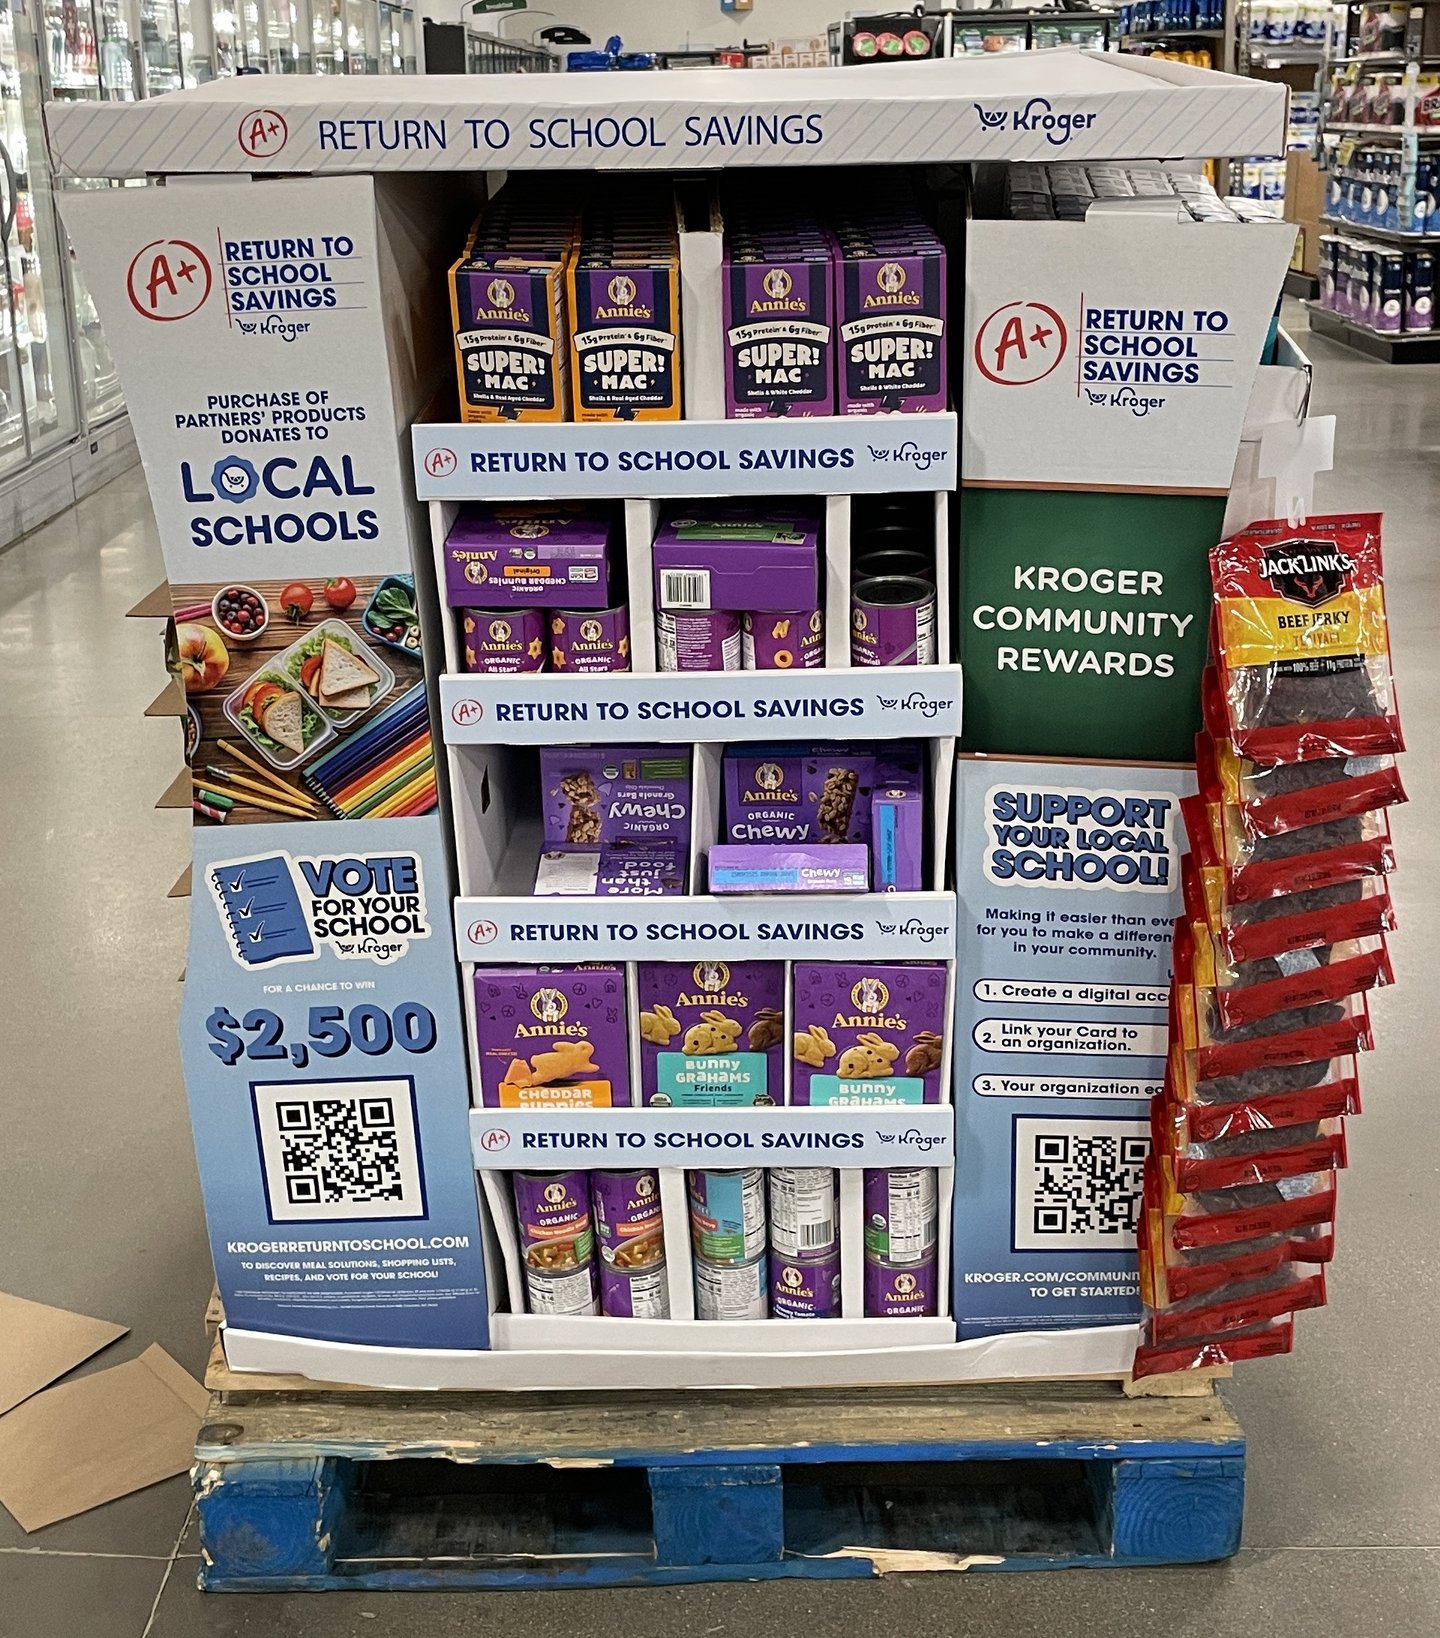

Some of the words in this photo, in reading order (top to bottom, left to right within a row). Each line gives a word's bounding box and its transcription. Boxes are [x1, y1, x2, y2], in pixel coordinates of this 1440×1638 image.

[1013, 98, 1097, 145] Kroger
[319, 119, 446, 149] RETURN
[464, 119, 510, 149] TO
[529, 117, 666, 148] SCHOOL
[685, 114, 823, 146] SAVINGS
[225, 238, 314, 262] RETURN
[321, 236, 354, 257] TO
[228, 263, 332, 287] SCHOOL
[231, 288, 337, 311] SAVINGS
[750, 298, 807, 314] Annie's
[863, 291, 920, 308] Annie's
[476, 307, 530, 323] Annie's
[595, 304, 652, 319] Annie's
[1086, 308, 1184, 331] RETURN
[1193, 311, 1228, 332] TO
[260, 314, 310, 342] Kroger
[738, 343, 820, 368] SUPER!
[850, 338, 934, 364] SUPER!
[1084, 335, 1198, 358] SCHOOL
[467, 351, 546, 376] SUPER!
[584, 350, 665, 374] SUPER!
[868, 363, 915, 380] MAC
[755, 368, 802, 384] MAC
[1083, 361, 1200, 383] SAVINGS
[485, 375, 528, 391] MAC
[602, 374, 648, 390] MAC
[208, 392, 300, 410] PURCHASE
[306, 390, 328, 405] OF
[1110, 386, 1166, 417] Kroger
[175, 412, 266, 429] PARTNERS'
[272, 407, 366, 424] PRODUCTS
[222, 427, 300, 444] DONATES
[306, 426, 328, 441] TO
[470, 452, 566, 473] RETURN
[574, 451, 609, 472] TO
[618, 450, 730, 472] SCHOOL
[739, 448, 855, 470] SAVINGS
[893, 441, 948, 470] Kroger
[181, 455, 375, 503] LOCAL
[191, 510, 379, 547] SCHOOLS
[1259, 558, 1304, 578] JACK
[1014, 565, 1164, 596] KROGER
[972, 605, 1194, 638] COMMUNITY
[1278, 614, 1309, 629] BEEF
[481, 640, 523, 651] Annie's
[571, 639, 614, 651] Annie's
[485, 657, 521, 665] ORGANIC
[575, 656, 611, 665] ORGANIC
[998, 647, 1175, 678] REWARDS
[496, 703, 588, 721] RETURN
[597, 703, 629, 720] TO
[638, 701, 745, 719] SCHOOL
[753, 698, 864, 718] SAVINGS
[901, 692, 953, 718] Kroger
[743, 789, 798, 803] Annie's
[609, 802, 686, 819] Chewy
[748, 811, 795, 820] ORGANIC
[993, 791, 1171, 829] SUPPORT
[624, 823, 669, 831] ORGANIC
[731, 823, 809, 840] Chewy
[993, 825, 1069, 849] YOUR
[1076, 828, 1169, 853] LOCAL
[801, 868, 840, 879] Chewy
[991, 849, 1169, 885] SCHOOL!
[299, 856, 418, 898] VOTE
[312, 899, 356, 917] FOR
[357, 896, 420, 915] YOUR
[314, 914, 425, 938] SCHOOL
[986, 908, 1041, 923] Making
[1046, 911, 1055, 922] it
[1060, 913, 1106, 924] easier
[1112, 914, 1146, 926] than
[1151, 918, 1175, 927] eve
[510, 924, 598, 941] RETURN
[607, 923, 638, 940] TO
[646, 924, 749, 940] SCHOOL
[757, 923, 864, 940] SAVINGS
[900, 918, 949, 942] Kroger
[977, 925, 996, 935] for
[1001, 927, 1027, 938] you
[1033, 927, 1047, 937] to
[1052, 929, 1094, 940] make
[1099, 932, 1108, 940] a
[358, 937, 402, 959] Kroger
[1014, 941, 1026, 952] in
[1032, 945, 1064, 955] your
[1069, 945, 1157, 960] community.
[263, 985, 283, 994] FOR
[286, 984, 293, 992] A
[294, 983, 338, 992] CHANCE
[340, 982, 353, 990] TO
[355, 981, 376, 989] WIN
[984, 984, 996, 995] 1.
[1002, 984, 1057, 998] Create
[1062, 990, 1073, 998] a
[1078, 988, 1130, 1002] digital
[676, 991, 748, 1008] Annie's
[514, 1021, 588, 1039] Annie's
[832, 1013, 907, 1031] Annie's
[1001, 1023, 1032, 1036] Link
[1037, 1026, 1072, 1039] your
[1076, 1026, 1117, 1038] Card
[1122, 1028, 1138, 1039] to
[205, 1001, 437, 1069] $2,500
[982, 1032, 996, 1044] 2.
[1001, 1038, 1021, 1048] an
[1027, 1038, 1131, 1051] organization.
[694, 1084, 732, 1092] Friends
[982, 1080, 996, 1091] 3.
[1001, 1080, 1035, 1092] Your
[1040, 1082, 1139, 1095] organization
[522, 1133, 607, 1148] RETURN
[616, 1132, 646, 1148] TO
[654, 1132, 754, 1148] SCHOOL
[761, 1132, 864, 1148] SAVINGS
[899, 1129, 947, 1151] Kroger
[536, 1198, 577, 1214] Annie's
[539, 1213, 578, 1226] ORGANIC
[227, 1236, 469, 1254] KROGERRETURNTOSCHOOL.COM
[255, 1261, 300, 1269] DISCOVER
[302, 1261, 326, 1269] MEAL
[328, 1260, 380, 1269] SOLUTIONS,
[382, 1258, 430, 1267] SHOPPING
[432, 1258, 456, 1267] LISTS,
[264, 1273, 302, 1282] RECIPES,
[304, 1273, 324, 1281] AND
[326, 1273, 349, 1281] VOTE
[351, 1272, 368, 1280] FOR
[371, 1272, 396, 1280] YOUR
[397, 1271, 438, 1279] SCHOOL!
[885, 1290, 925, 1302] Annie's
[1030, 1287, 1048, 1297] TO
[1052, 1286, 1076, 1297] GET
[1080, 1286, 1140, 1296] STARTED!
